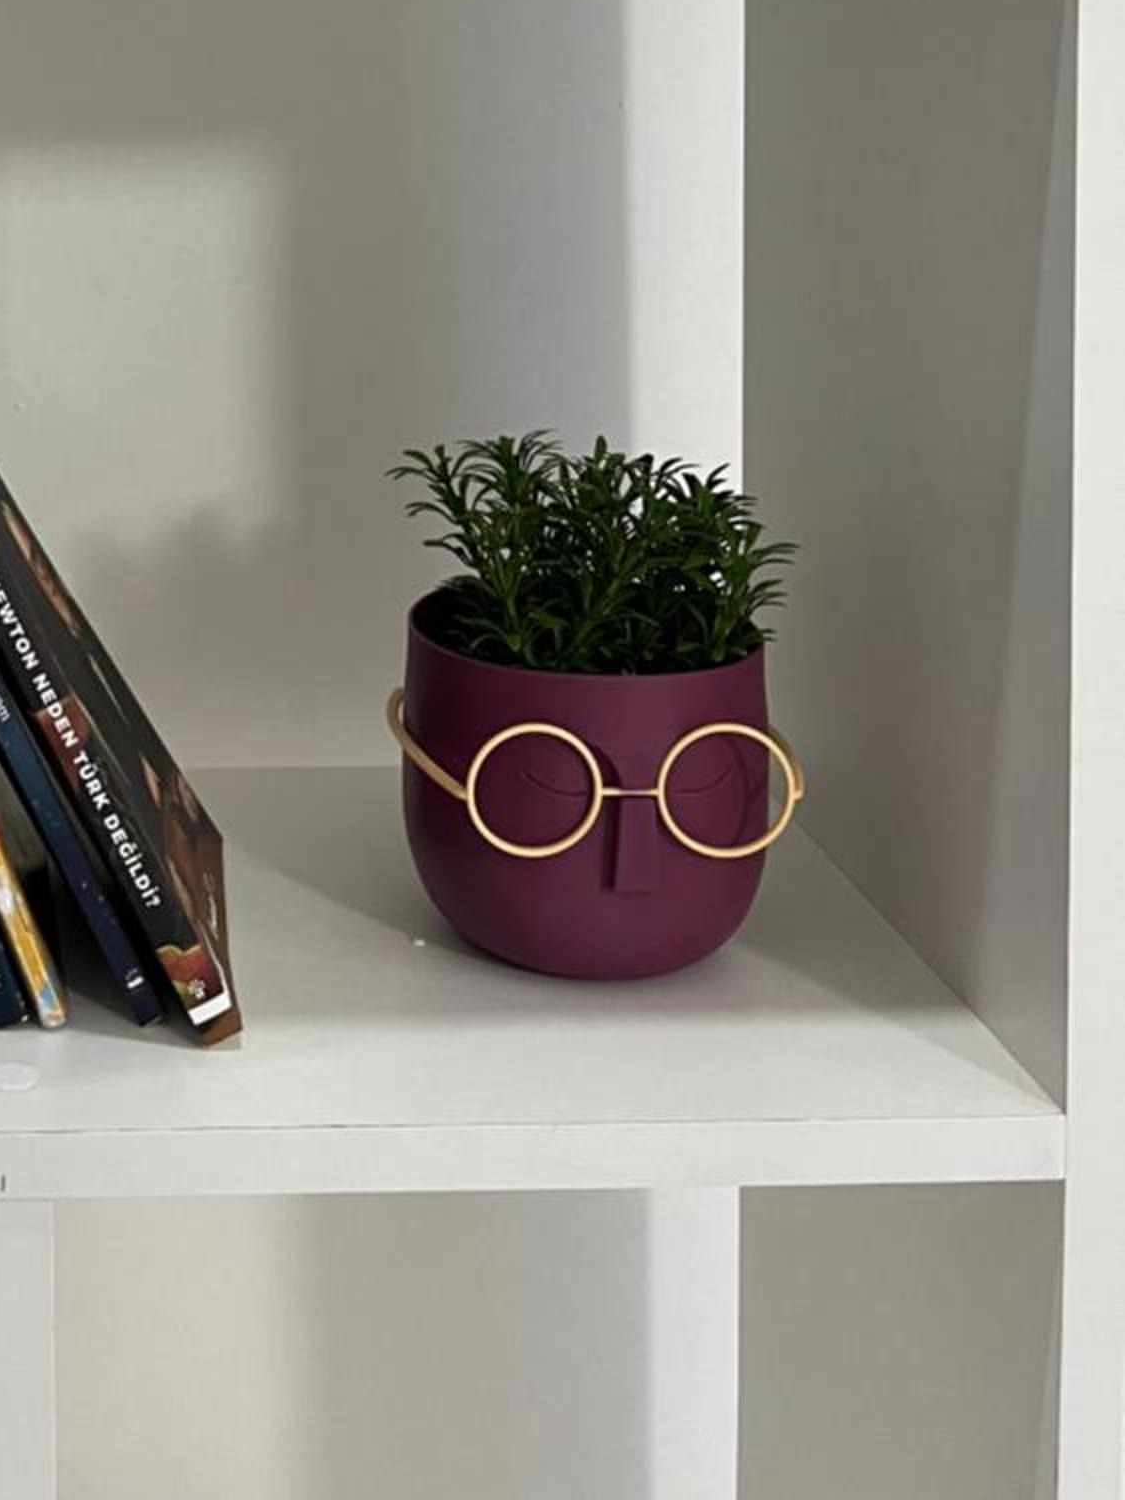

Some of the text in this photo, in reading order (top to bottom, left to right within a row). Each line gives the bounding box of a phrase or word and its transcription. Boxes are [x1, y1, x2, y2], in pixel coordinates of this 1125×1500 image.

[33, 673, 79, 748] NEDEN
[72, 750, 110, 810] TÜRK
[104, 813, 161, 909] DEĞİLDİ?
